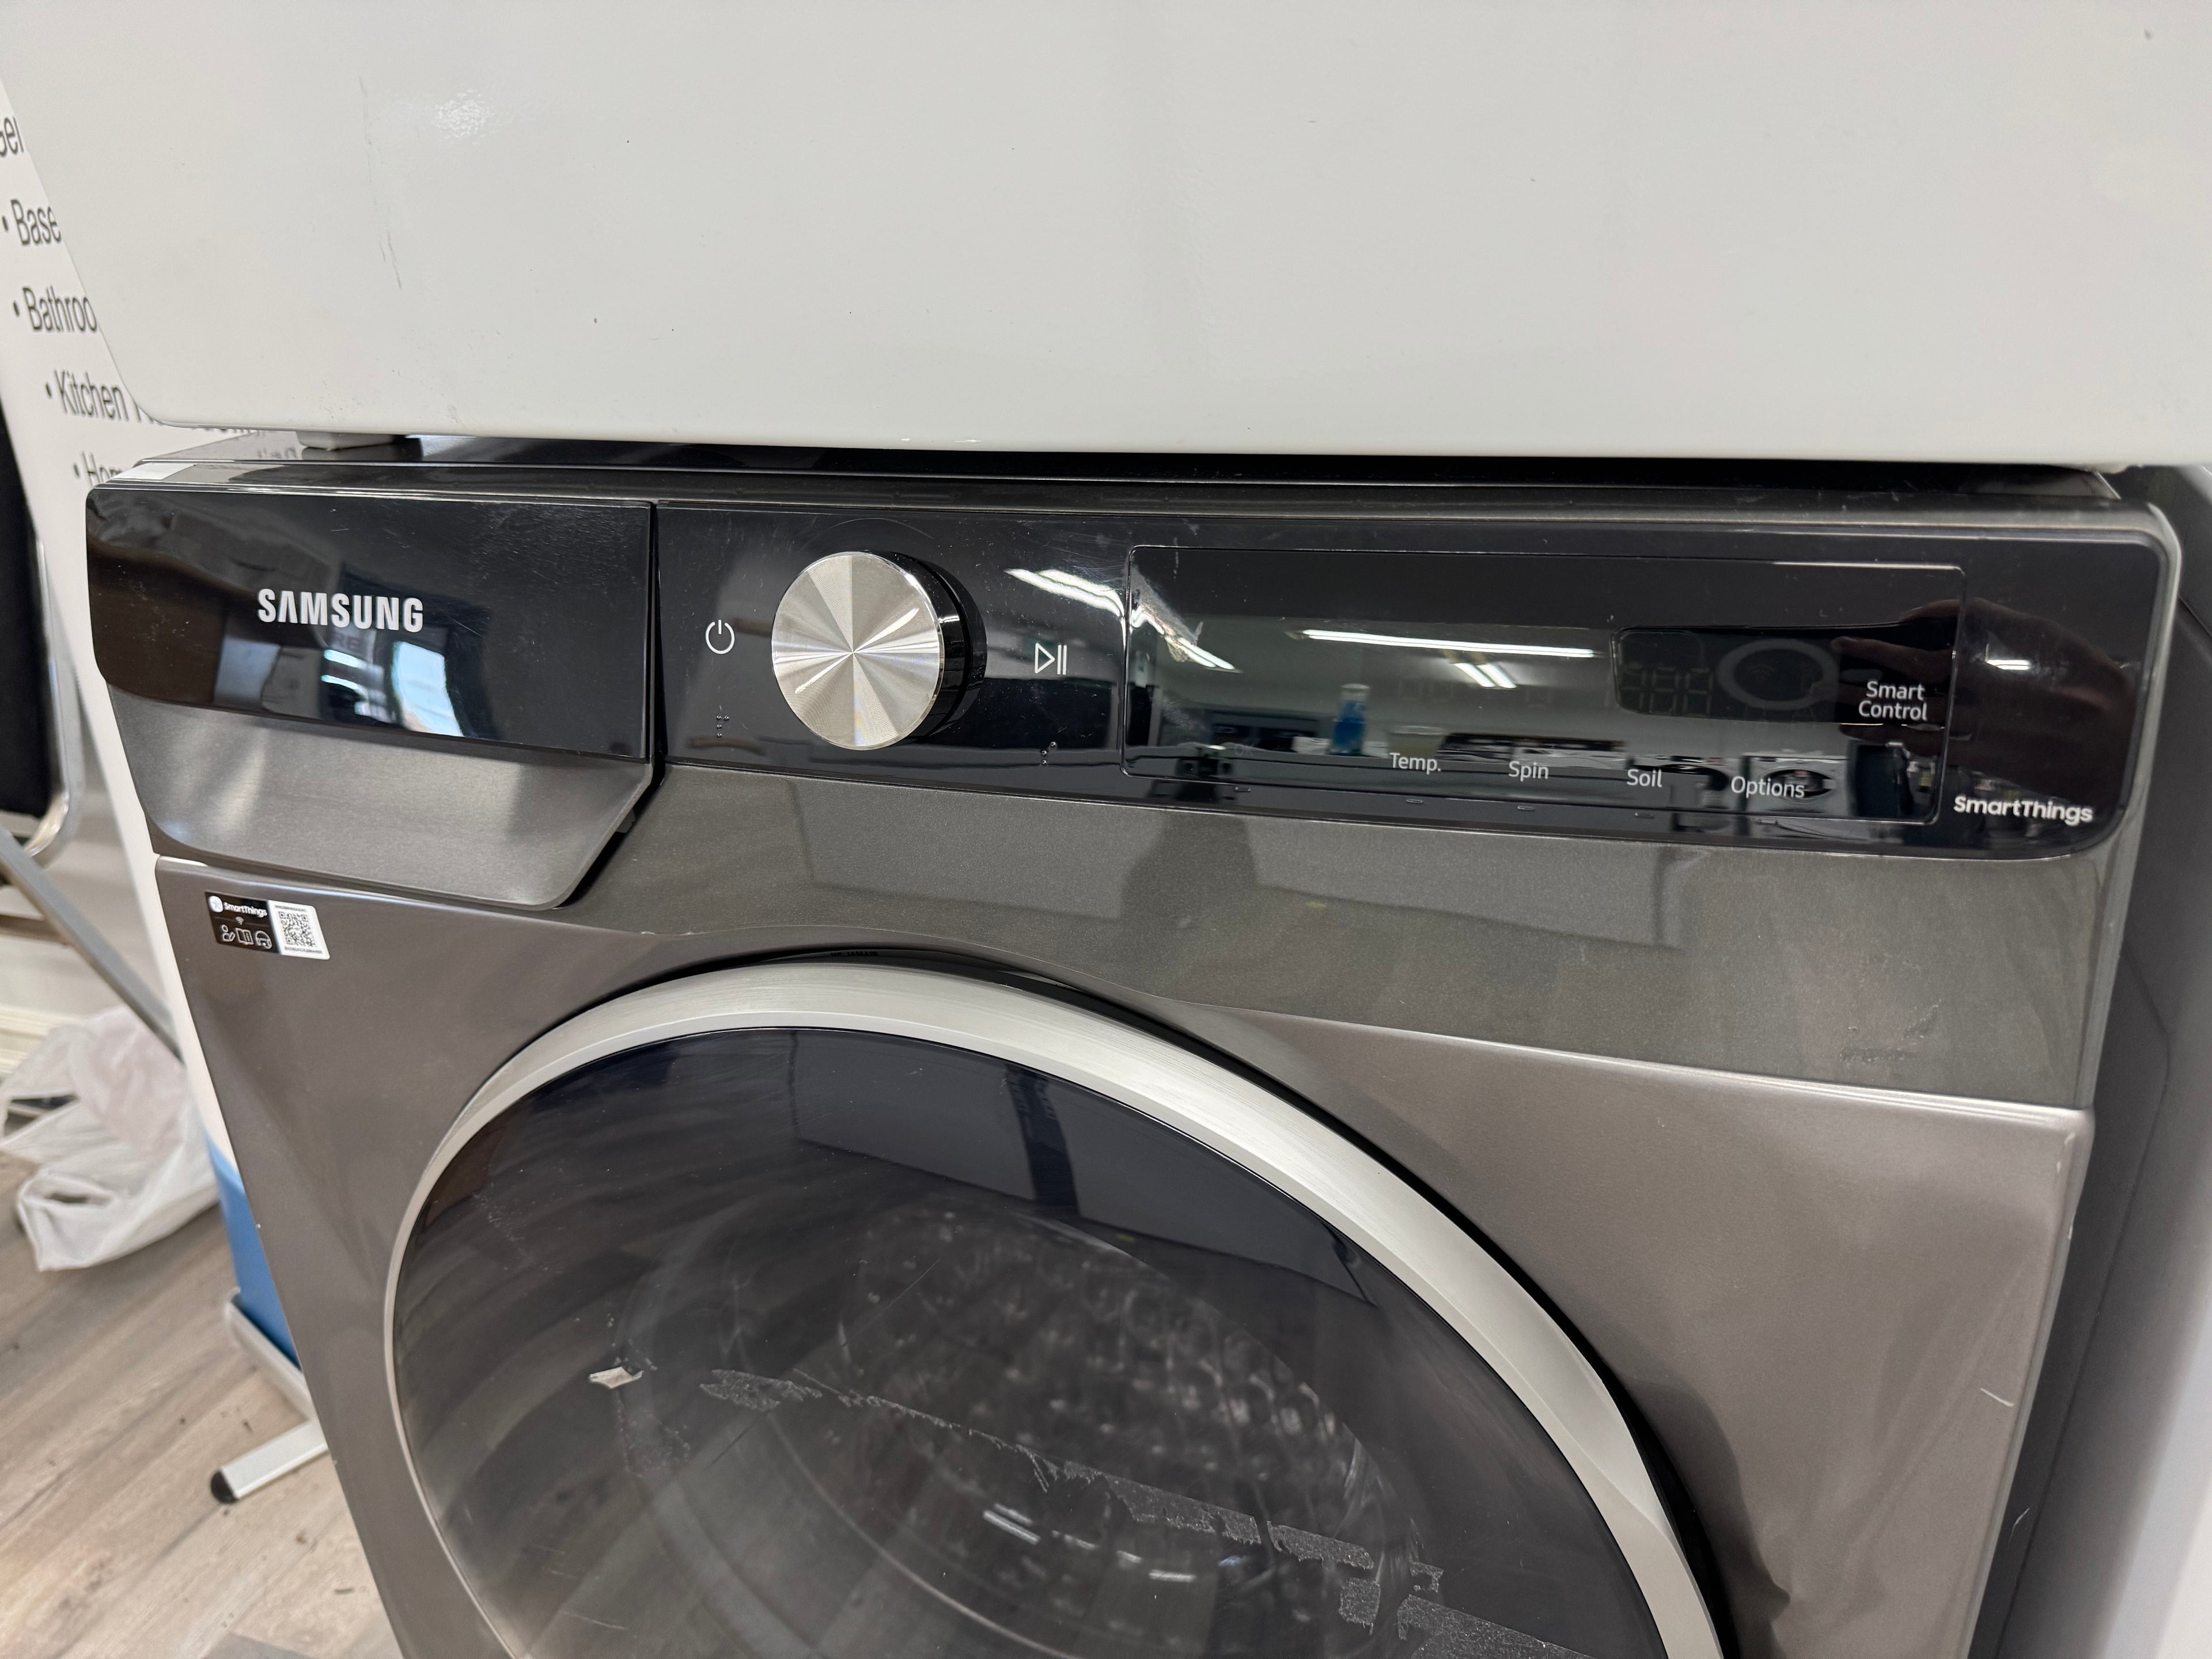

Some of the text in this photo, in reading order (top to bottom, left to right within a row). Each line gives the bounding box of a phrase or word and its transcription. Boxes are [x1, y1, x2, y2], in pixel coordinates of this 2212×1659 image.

[22, 285, 97, 332] Bathroo
[55, 369, 129, 421] Kitchen
[258, 588, 423, 632] SAMSUNG
[1866, 681, 1926, 700] Smart
[1858, 700, 1927, 721] Control
[1389, 753, 1441, 774] Temp.
[1508, 761, 1549, 781] Spin
[1627, 769, 1662, 787] Soil
[1731, 776, 1805, 798] Options
[1953, 795, 2093, 825] SmartThings
[224, 902, 268, 918] SmartThings
